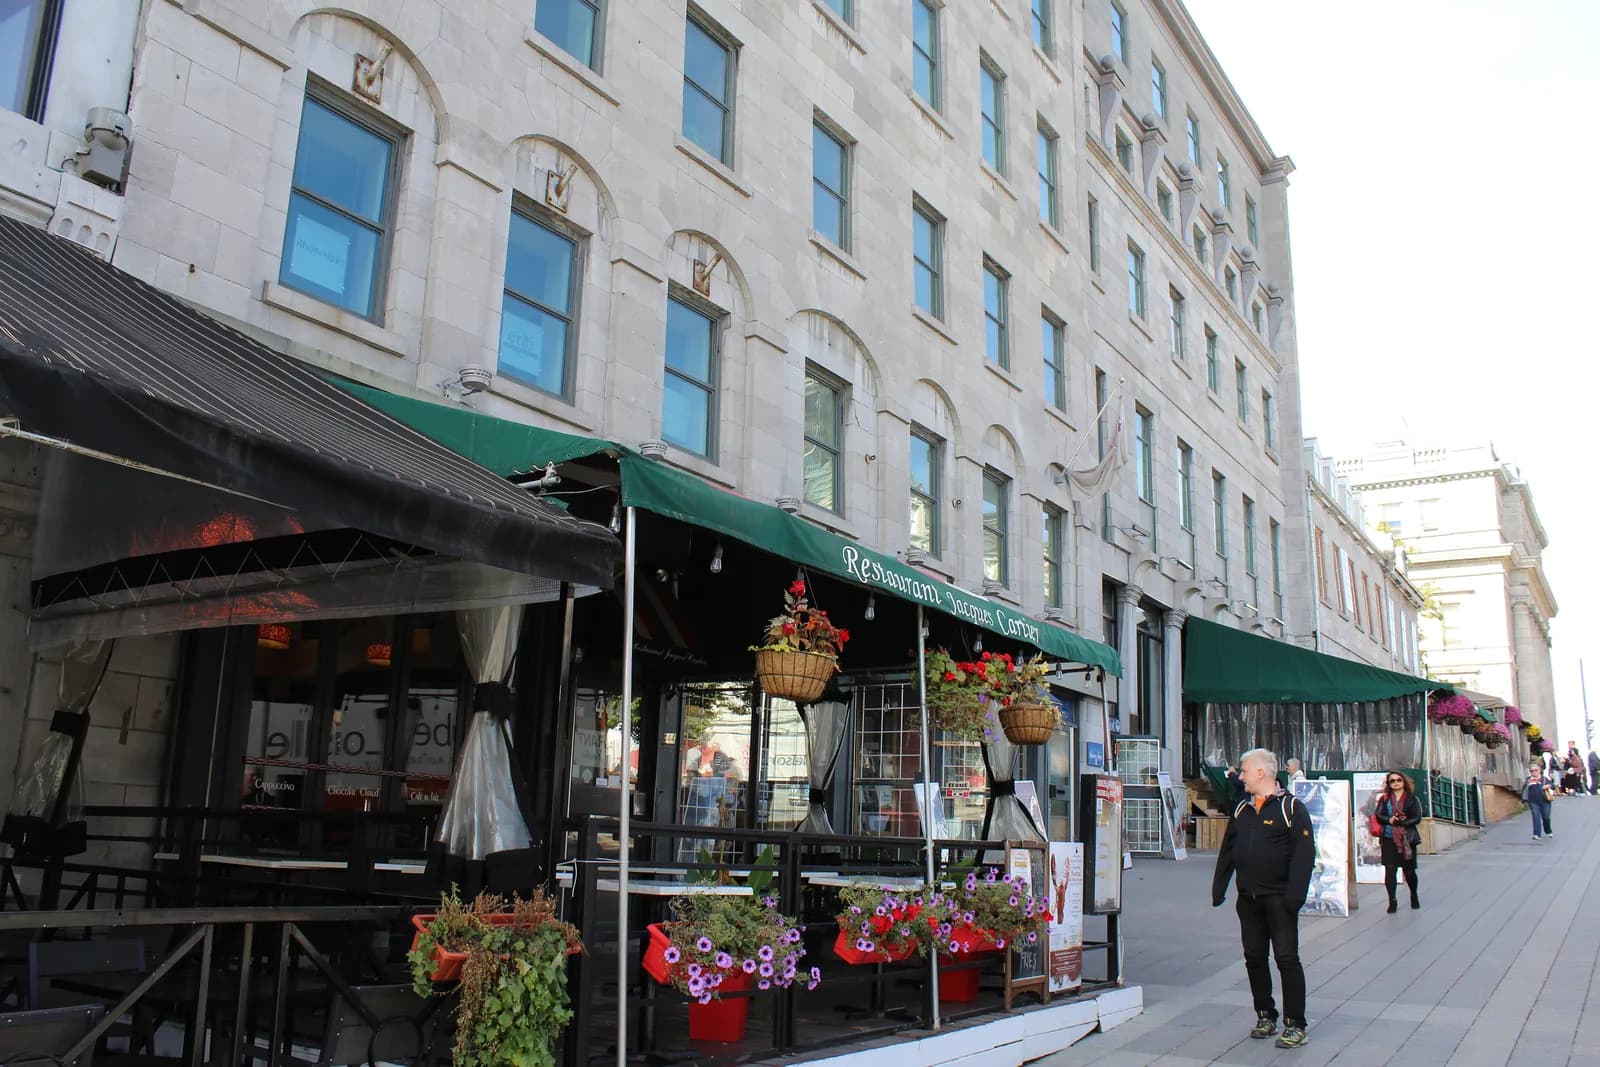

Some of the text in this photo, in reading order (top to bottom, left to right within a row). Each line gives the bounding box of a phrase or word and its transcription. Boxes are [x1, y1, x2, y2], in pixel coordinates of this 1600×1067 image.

[843, 545, 1040, 644] Restaurant Jacques Cartier
[255, 778, 296, 793] Cappuccino
